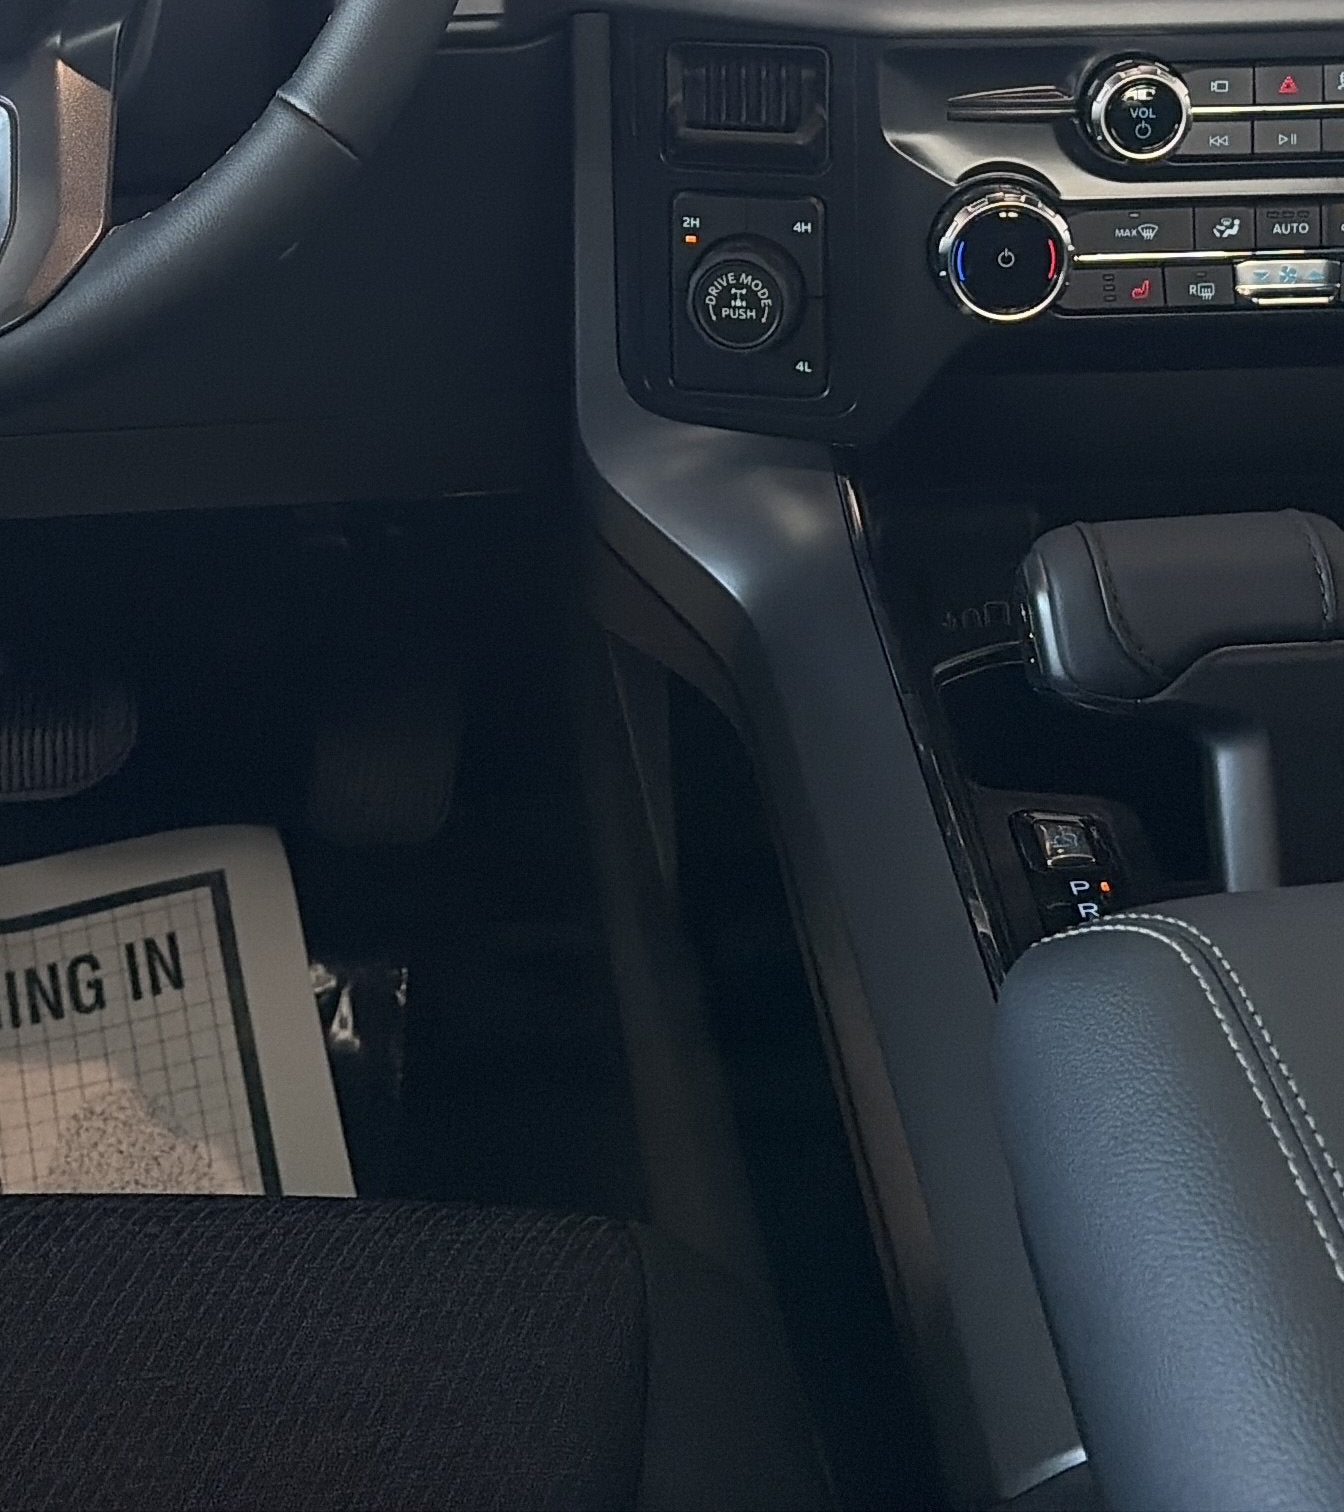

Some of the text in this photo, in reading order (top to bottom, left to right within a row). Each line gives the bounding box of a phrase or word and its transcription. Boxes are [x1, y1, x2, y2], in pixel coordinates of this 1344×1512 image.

[1130, 107, 1157, 120] VOL
[682, 216, 700, 228] 2H
[793, 222, 812, 233] 4H
[1115, 228, 1137, 237] MAX
[1272, 223, 1309, 235] AUTO
[706, 272, 772, 307] DRIVE MODE
[721, 307, 756, 320] PUSH
[795, 360, 812, 373] 4L
[1068, 880, 1091, 896] P
[1077, 902, 1101, 918] R
[125, 931, 185, 1001] IN
